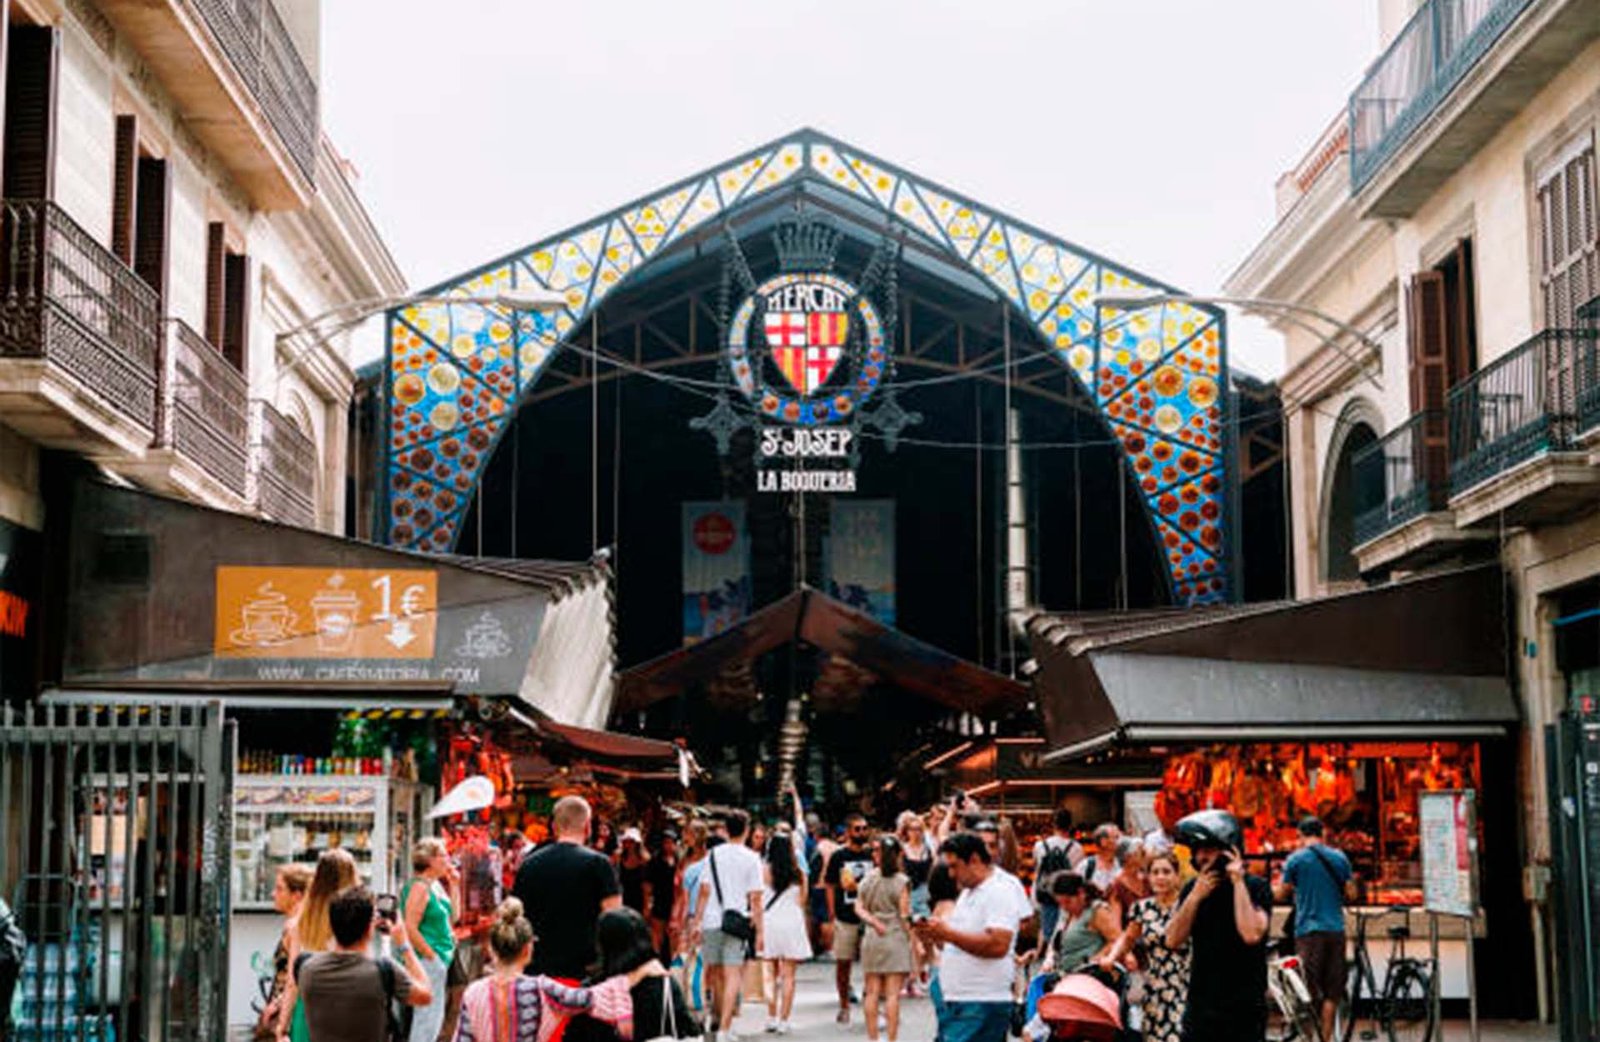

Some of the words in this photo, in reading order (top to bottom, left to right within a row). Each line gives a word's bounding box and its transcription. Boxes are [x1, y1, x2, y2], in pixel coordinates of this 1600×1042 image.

[768, 284, 846, 311] MERCAT
[782, 428, 853, 456] JOSEP
[757, 470, 778, 492] LA
[781, 470, 856, 492] BOQUERIA
